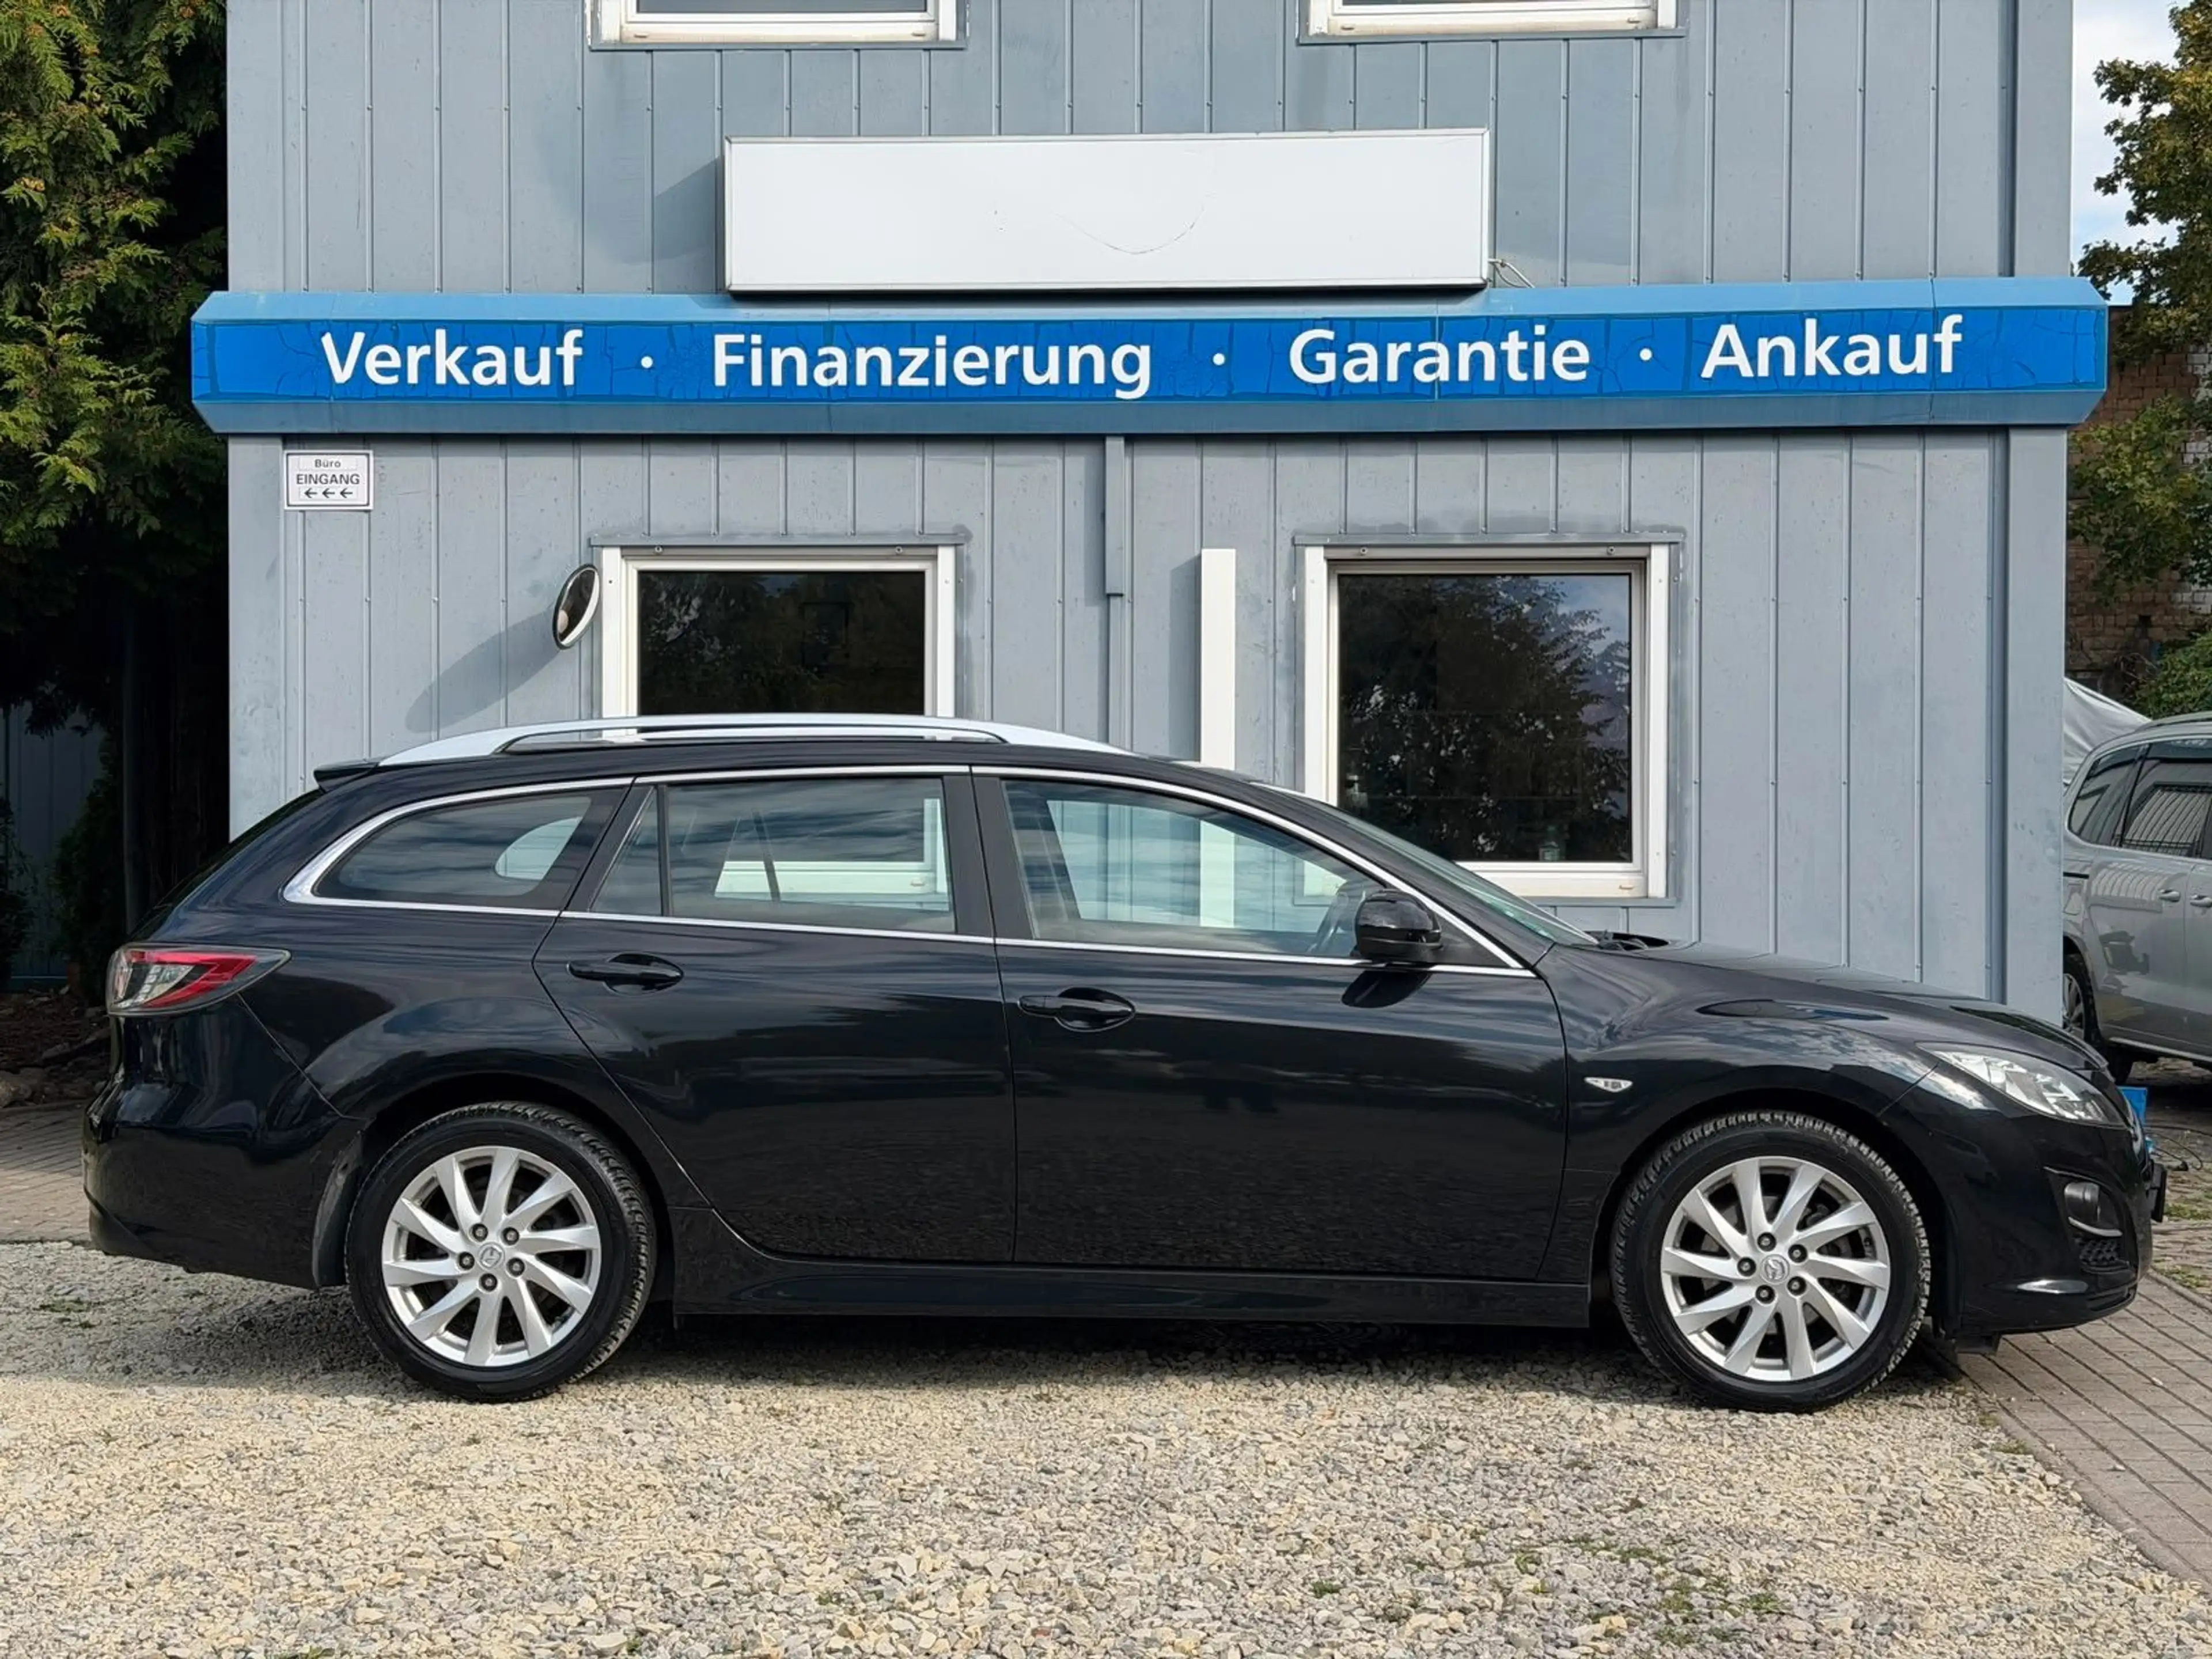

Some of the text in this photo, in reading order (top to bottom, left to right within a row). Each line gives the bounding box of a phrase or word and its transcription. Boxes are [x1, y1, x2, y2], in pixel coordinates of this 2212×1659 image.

[322, 314, 1963, 399] Verkauf Finanzierung Garantie Ankauf
[315, 459, 342, 468] Büro
[296, 474, 360, 485] EINGANG
